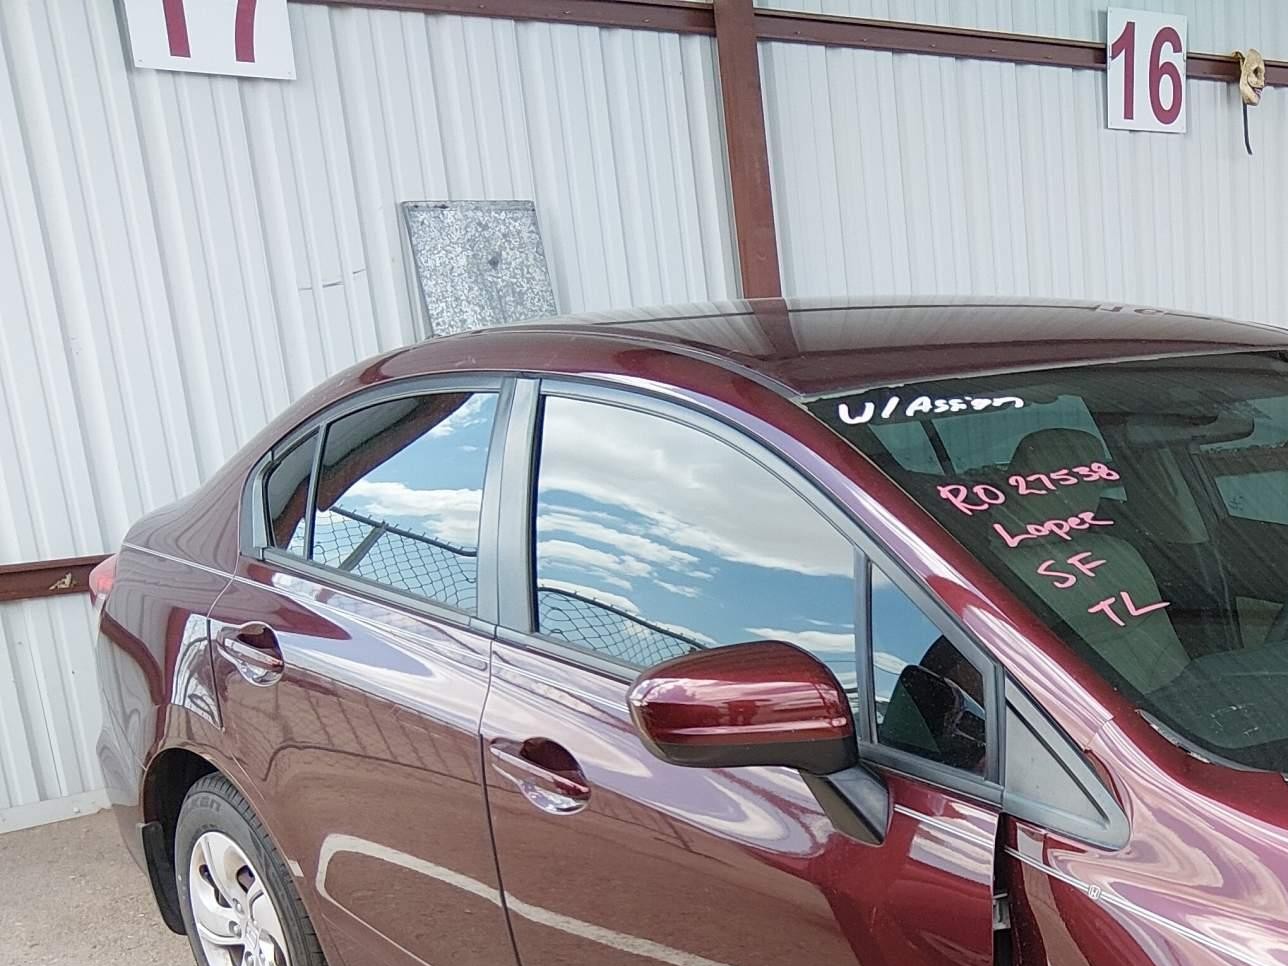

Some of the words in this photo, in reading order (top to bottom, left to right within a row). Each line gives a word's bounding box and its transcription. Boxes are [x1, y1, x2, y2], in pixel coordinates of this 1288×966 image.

[1111, 21, 1183, 125] 16
[937, 483, 1006, 516] RO
[1008, 462, 1121, 496] 27538
[1037, 551, 1107, 588] SF
[1088, 591, 1171, 627] TL
